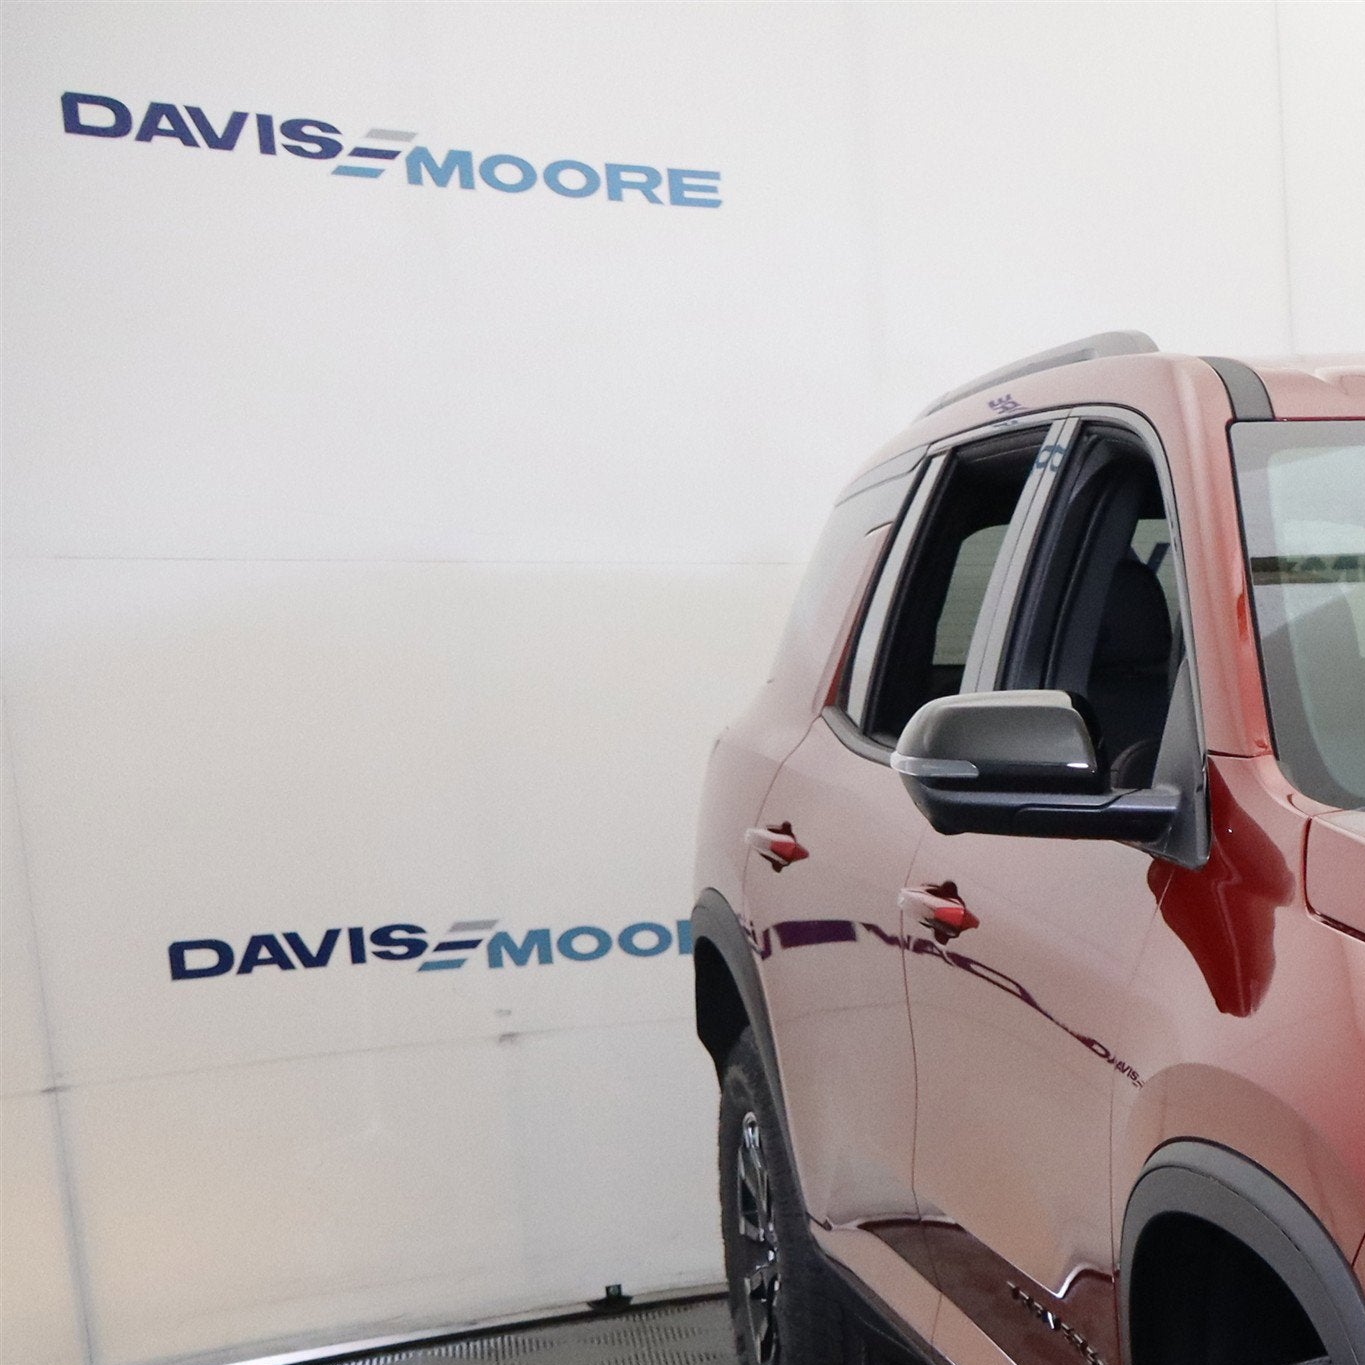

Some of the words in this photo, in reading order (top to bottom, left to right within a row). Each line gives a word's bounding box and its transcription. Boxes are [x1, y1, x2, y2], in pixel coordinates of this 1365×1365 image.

[60, 90, 343, 160] DAVIS
[404, 145, 724, 209] MOORE
[168, 923, 430, 981] DAVIS
[488, 919, 694, 970] MOO
